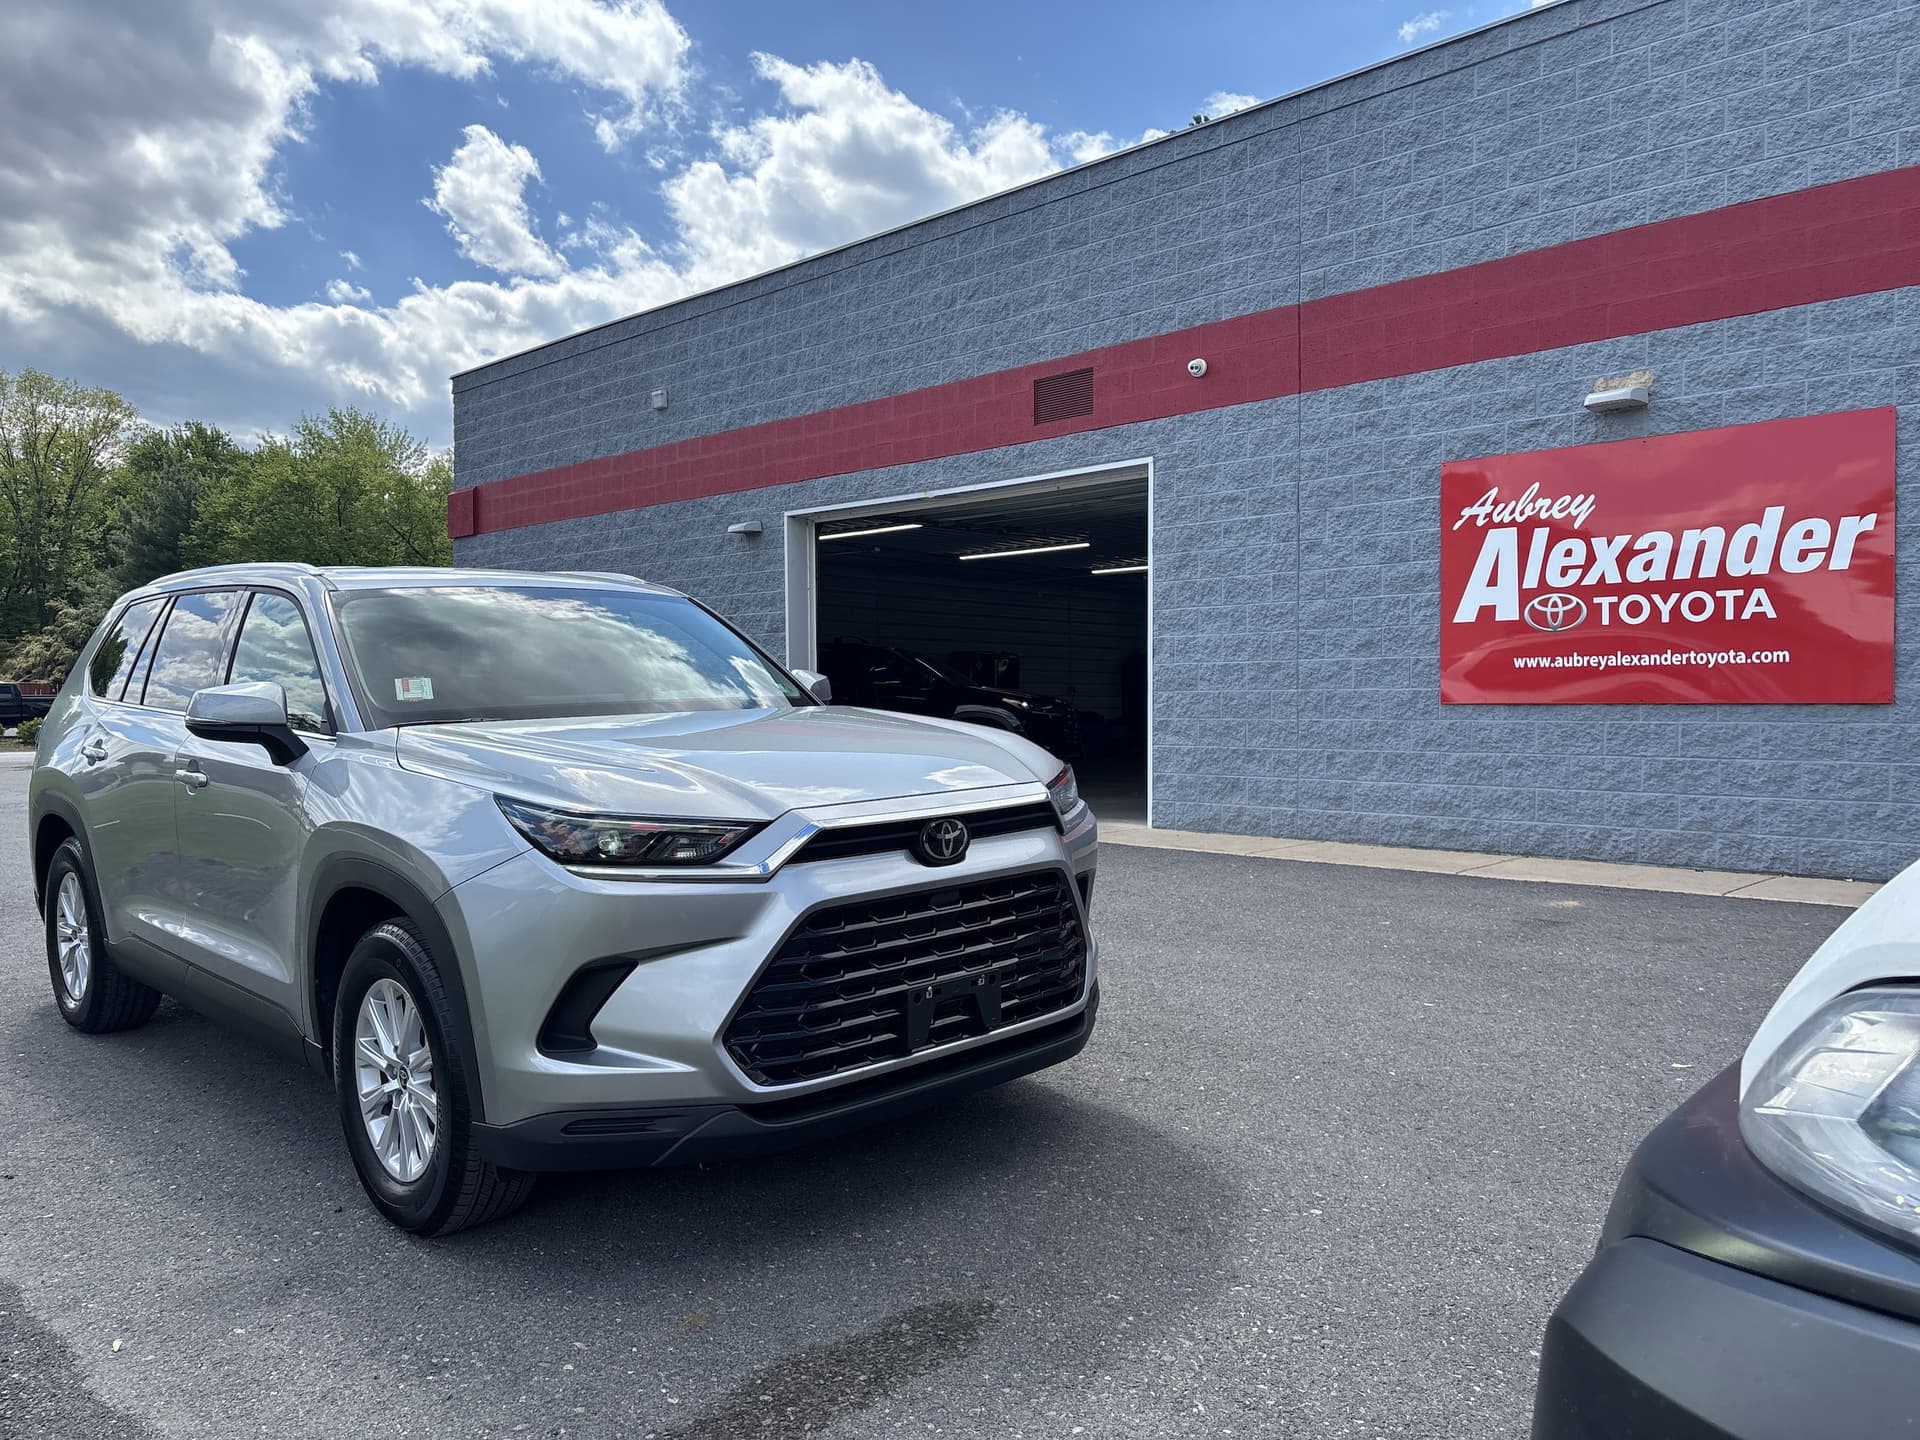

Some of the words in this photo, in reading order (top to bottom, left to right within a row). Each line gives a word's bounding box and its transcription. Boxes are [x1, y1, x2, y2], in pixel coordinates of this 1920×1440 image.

[1452, 481, 1596, 530] Aubrey
[1452, 505, 1878, 623] Alexander
[1593, 588, 1777, 626] TOYOTA
[1513, 648, 1790, 670] www.aubreyalexandertoyota.com
